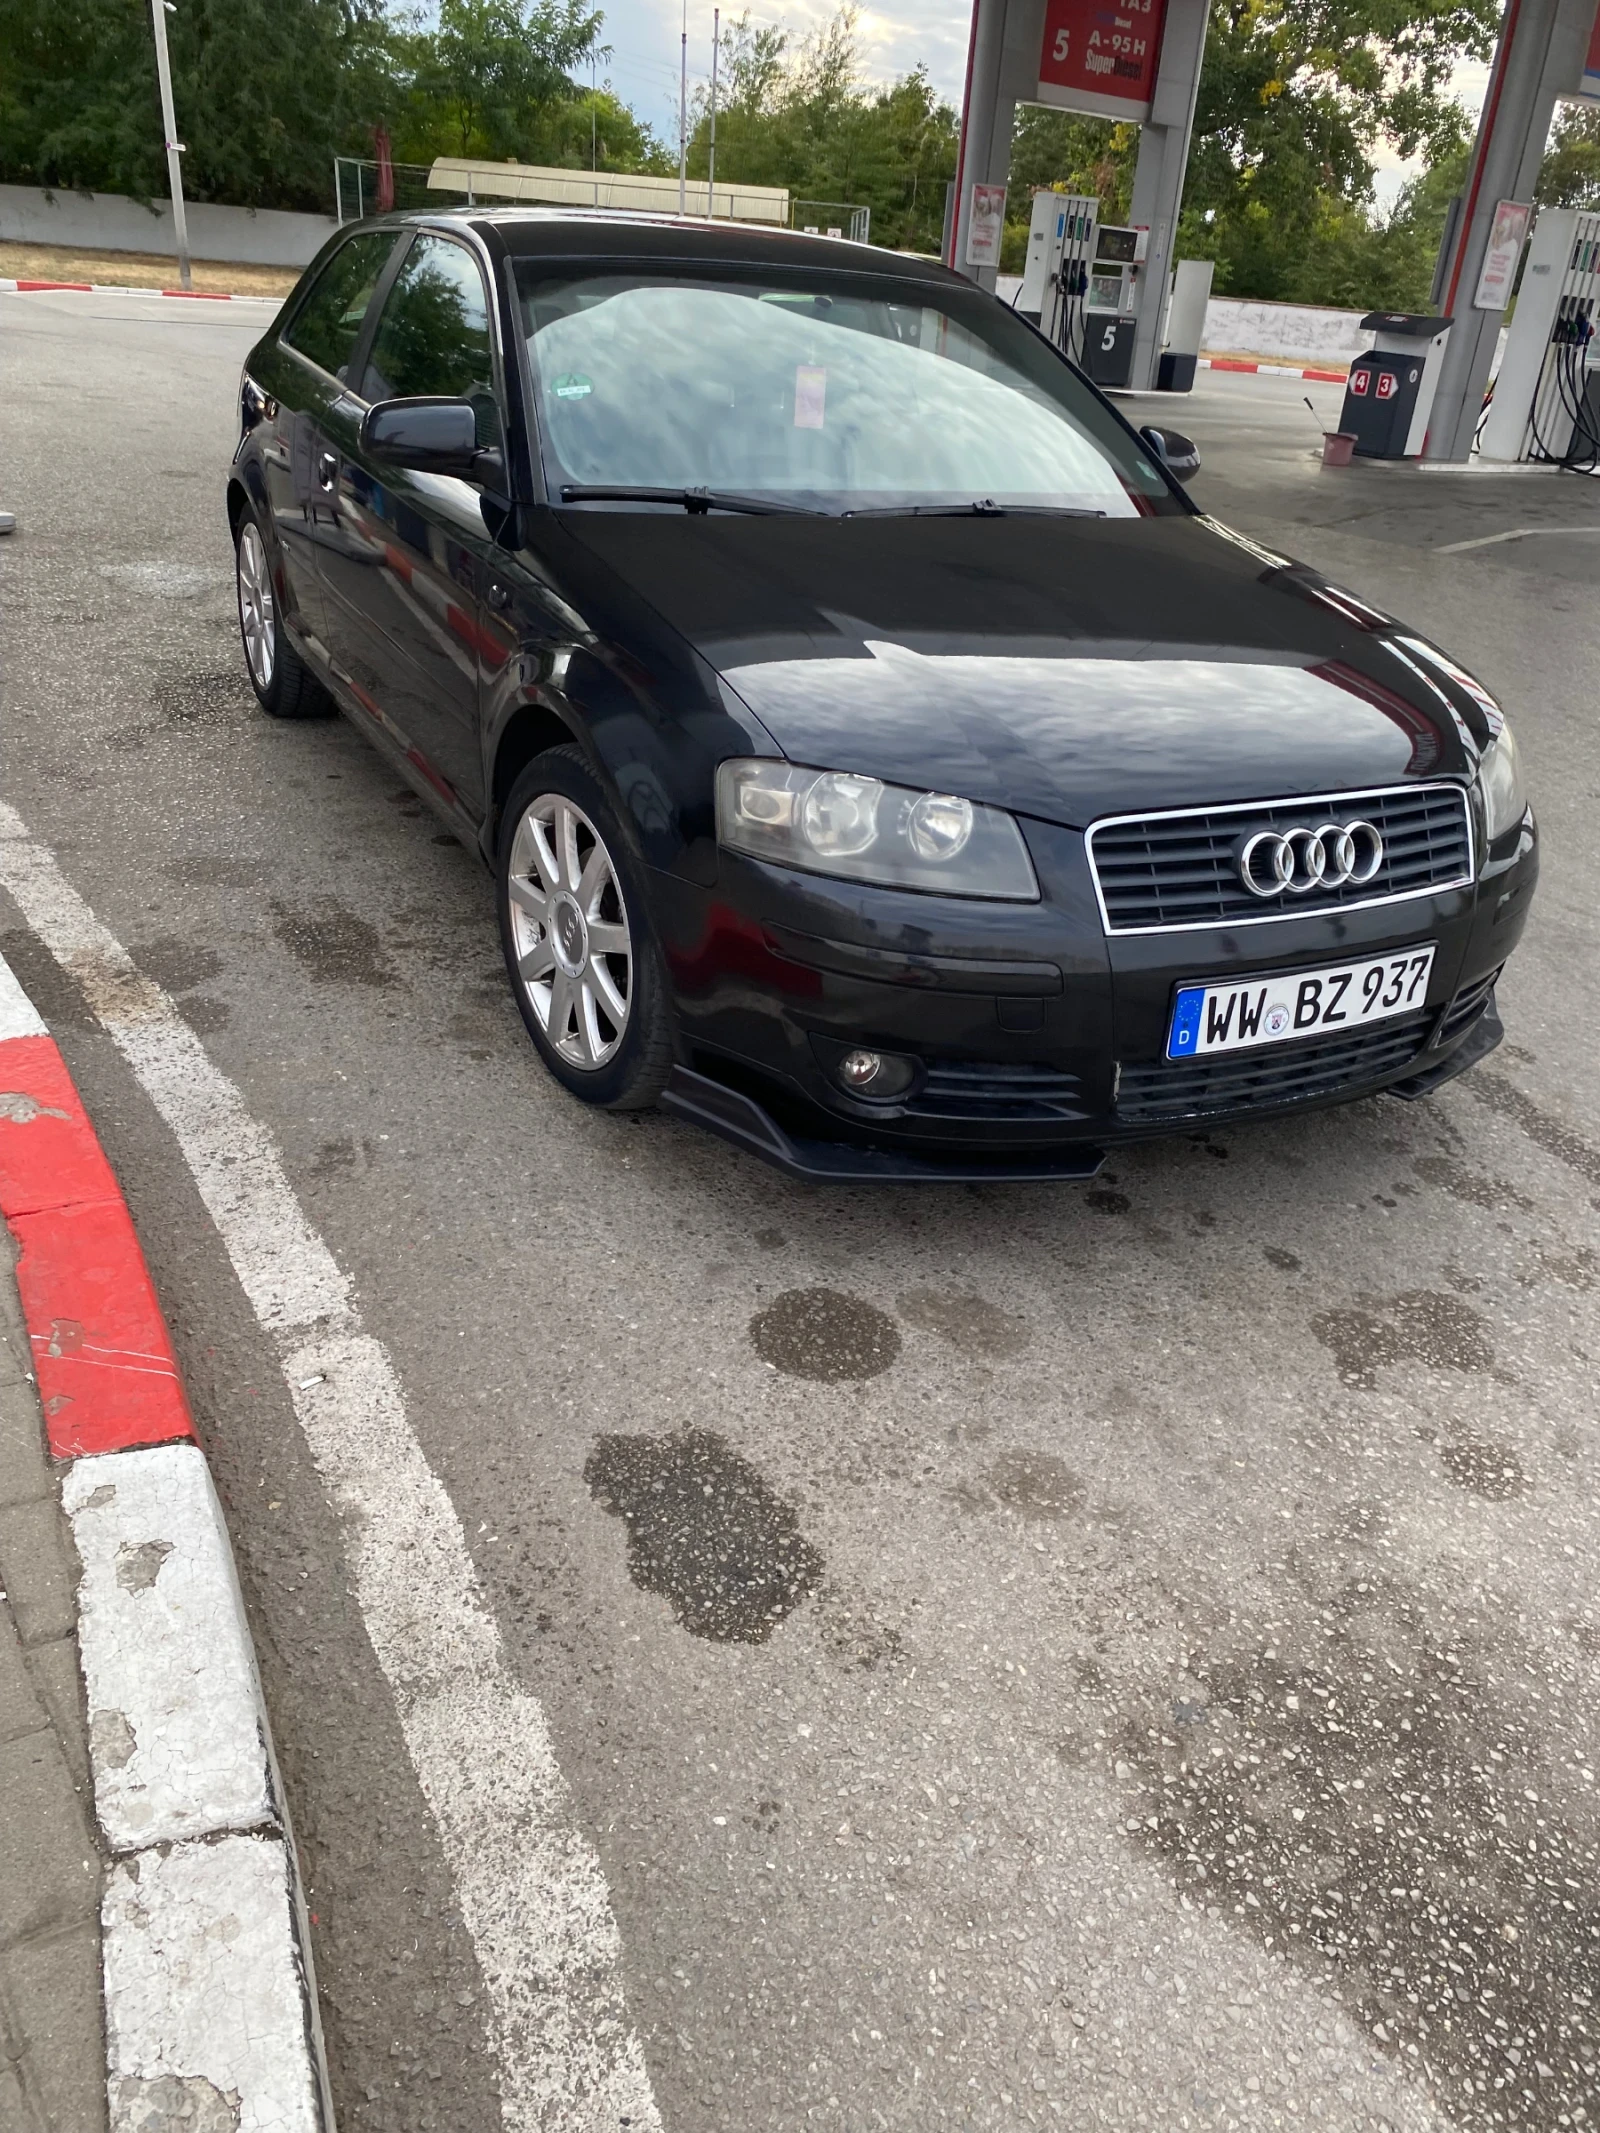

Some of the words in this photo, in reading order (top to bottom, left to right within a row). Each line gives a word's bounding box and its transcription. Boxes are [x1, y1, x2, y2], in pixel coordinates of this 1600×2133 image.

[1052, 28, 1070, 61] 5
[1101, 325, 1117, 352] 5
[1356, 375, 1366, 390] 4
[1380, 378, 1390, 393] 3
[1206, 987, 1268, 1044] WW
[1293, 972, 1353, 1030] BZ
[1361, 954, 1431, 1015] 937
[1178, 1029, 1190, 1045] D
